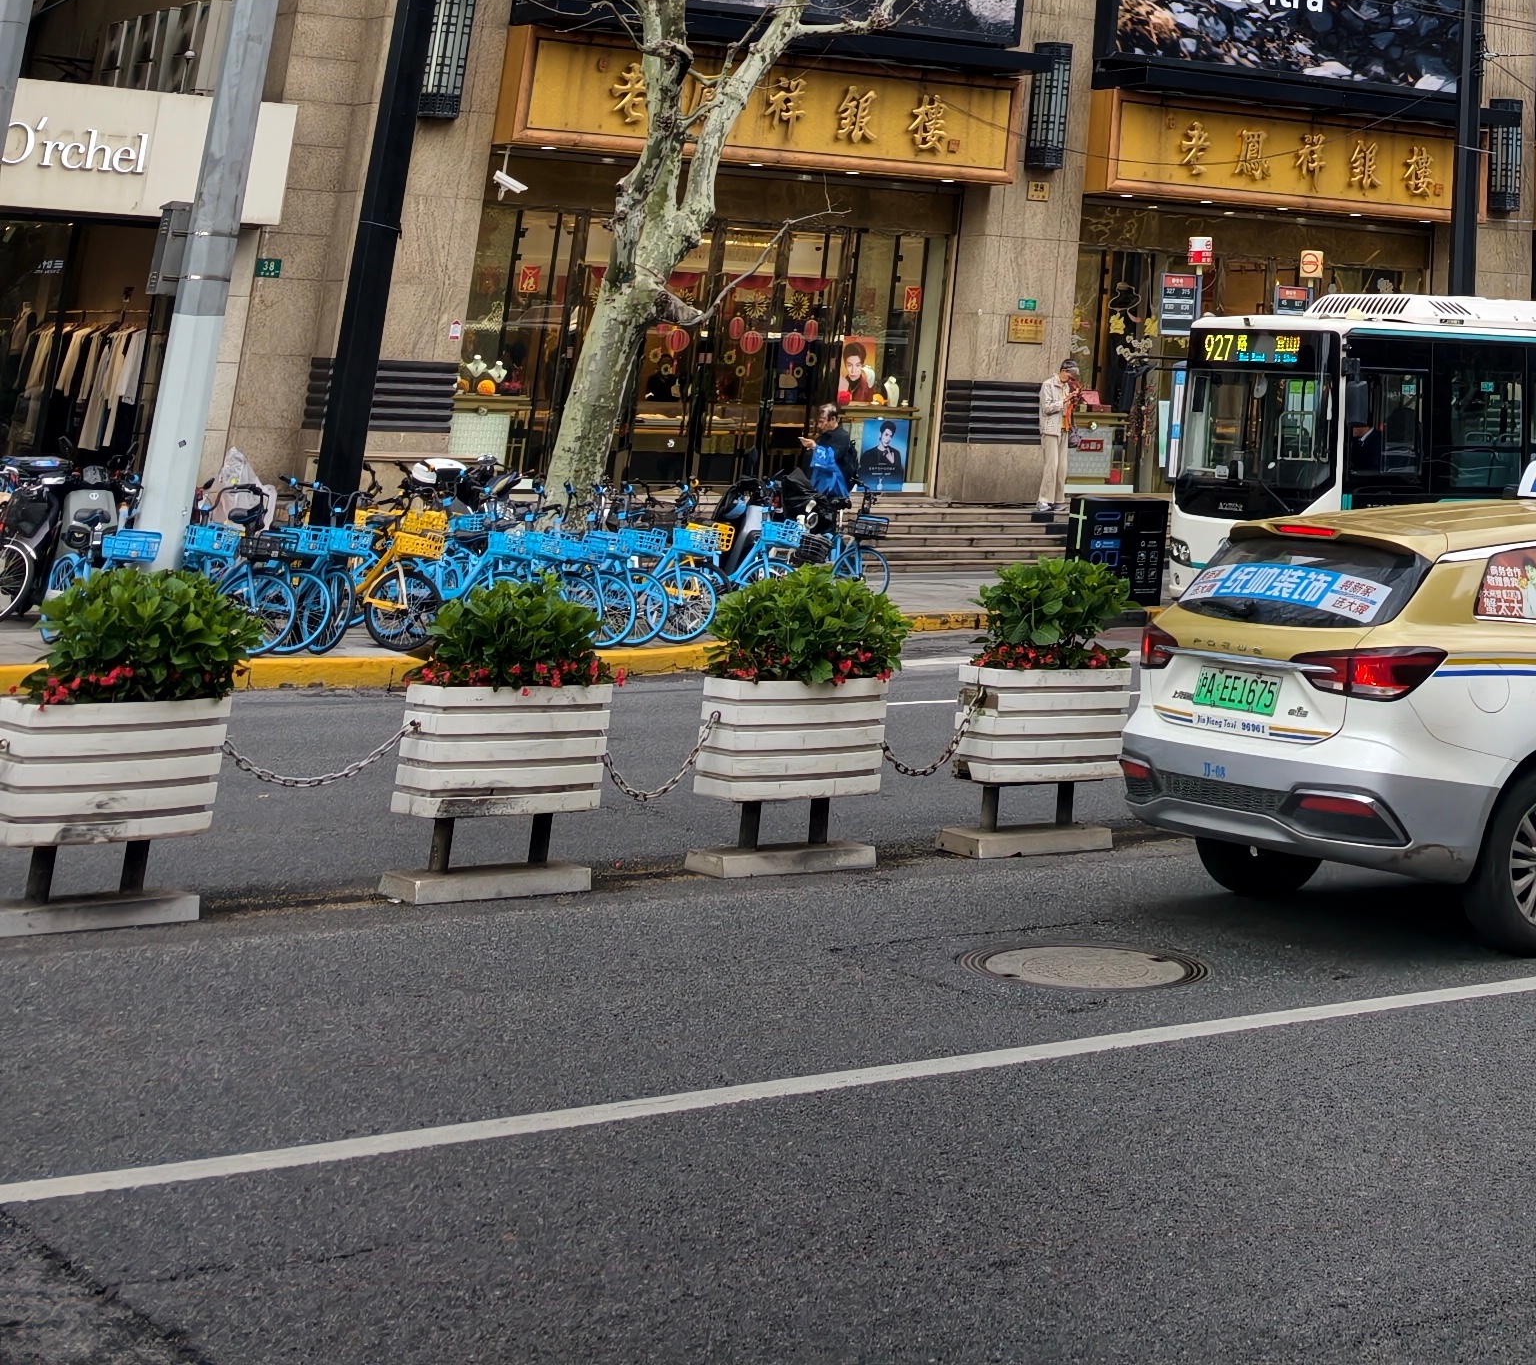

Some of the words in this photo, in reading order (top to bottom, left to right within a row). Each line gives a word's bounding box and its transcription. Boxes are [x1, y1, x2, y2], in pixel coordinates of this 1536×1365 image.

[262, 260, 275, 271] 38
[1219, 566, 1334, 603] 统帅装饰
[1332, 596, 1371, 616] 选大牌
[1223, 718, 1237, 730] Taxi
[1241, 721, 1266, 734] 96961
[1203, 762, 1226, 779] JJ-08
